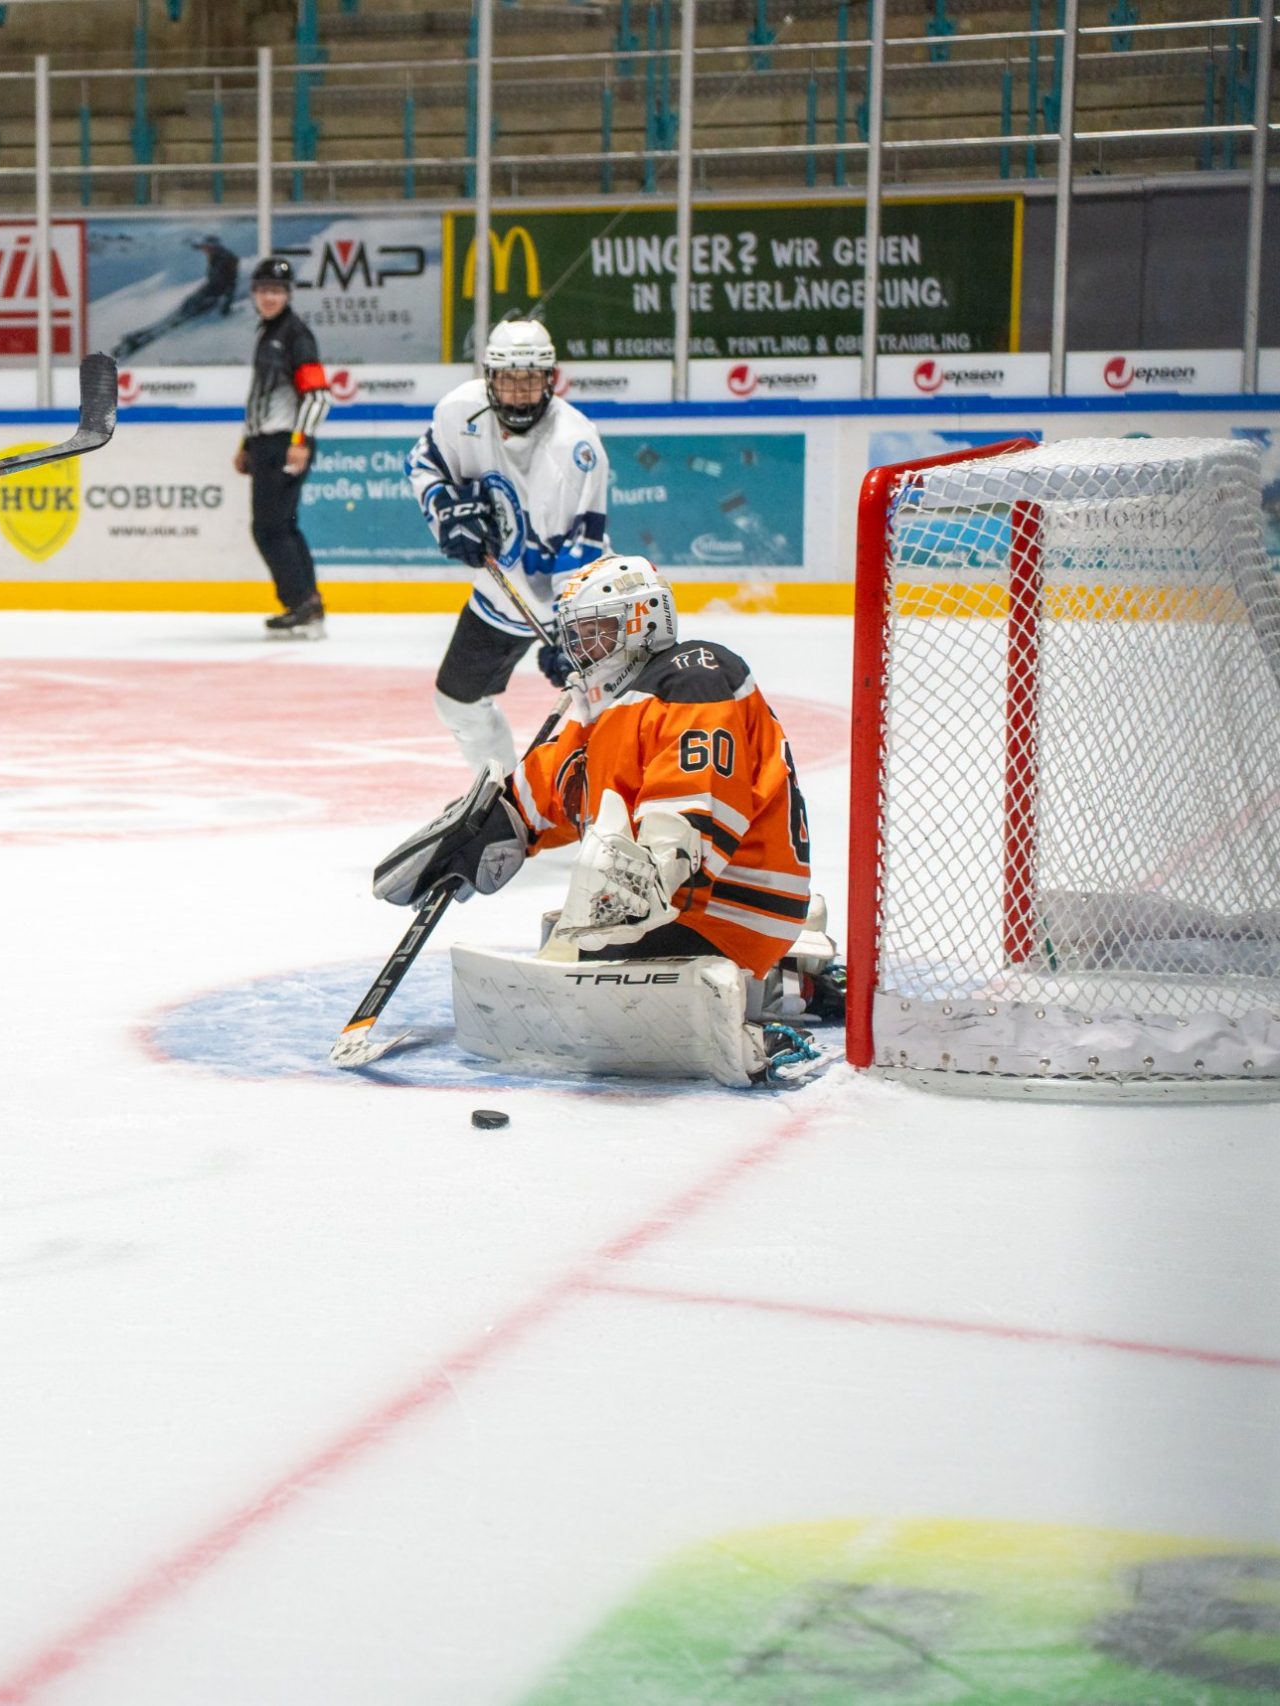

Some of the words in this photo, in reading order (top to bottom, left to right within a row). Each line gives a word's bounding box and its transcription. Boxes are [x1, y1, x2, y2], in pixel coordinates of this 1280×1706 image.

[303, 310, 413, 326] EGENSBURG
[311, 450, 366, 474] leine
[371, 451, 405, 474] Chi
[0, 486, 75, 512] HUK
[85, 484, 224, 510] COBURG
[366, 478, 416, 501] Wirk
[677, 727, 736, 779] 60
[564, 973, 680, 986] TRUE
